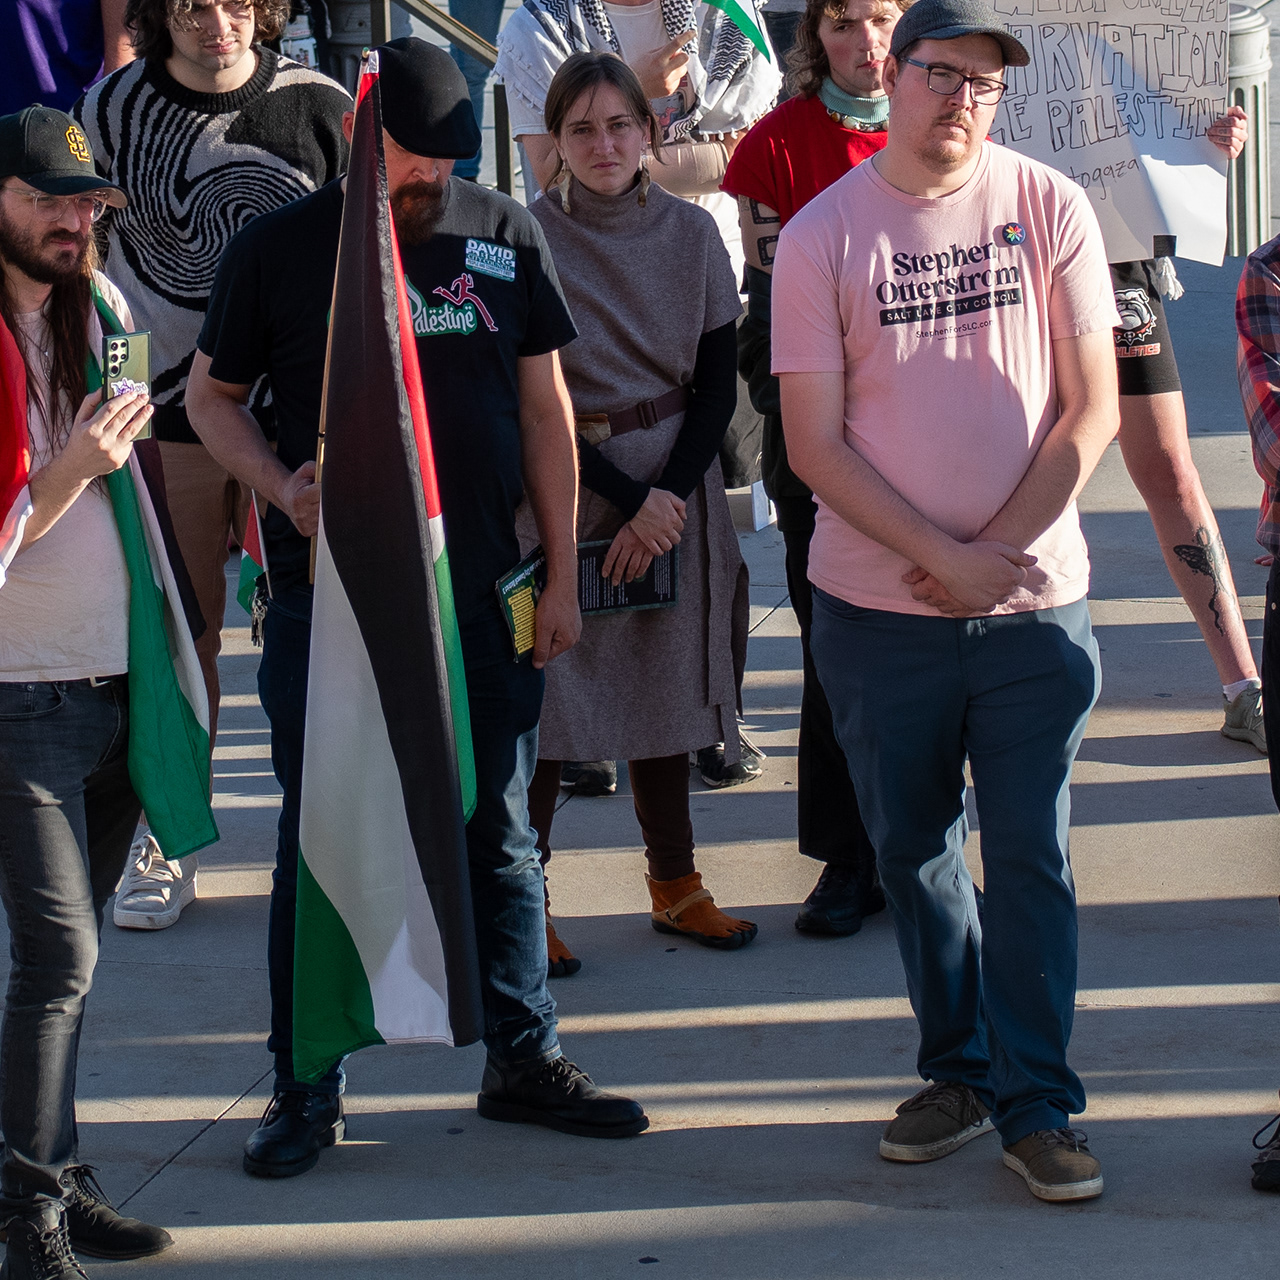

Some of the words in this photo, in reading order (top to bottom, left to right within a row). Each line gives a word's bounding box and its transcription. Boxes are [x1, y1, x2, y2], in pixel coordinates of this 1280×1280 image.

[1004, 22, 1228, 97] ARVATION
[467, 240, 513, 260] DAVID
[876, 264, 1020, 304] Otterstrom
[887, 310, 912, 321] SALT
[946, 302, 969, 313] CTY
